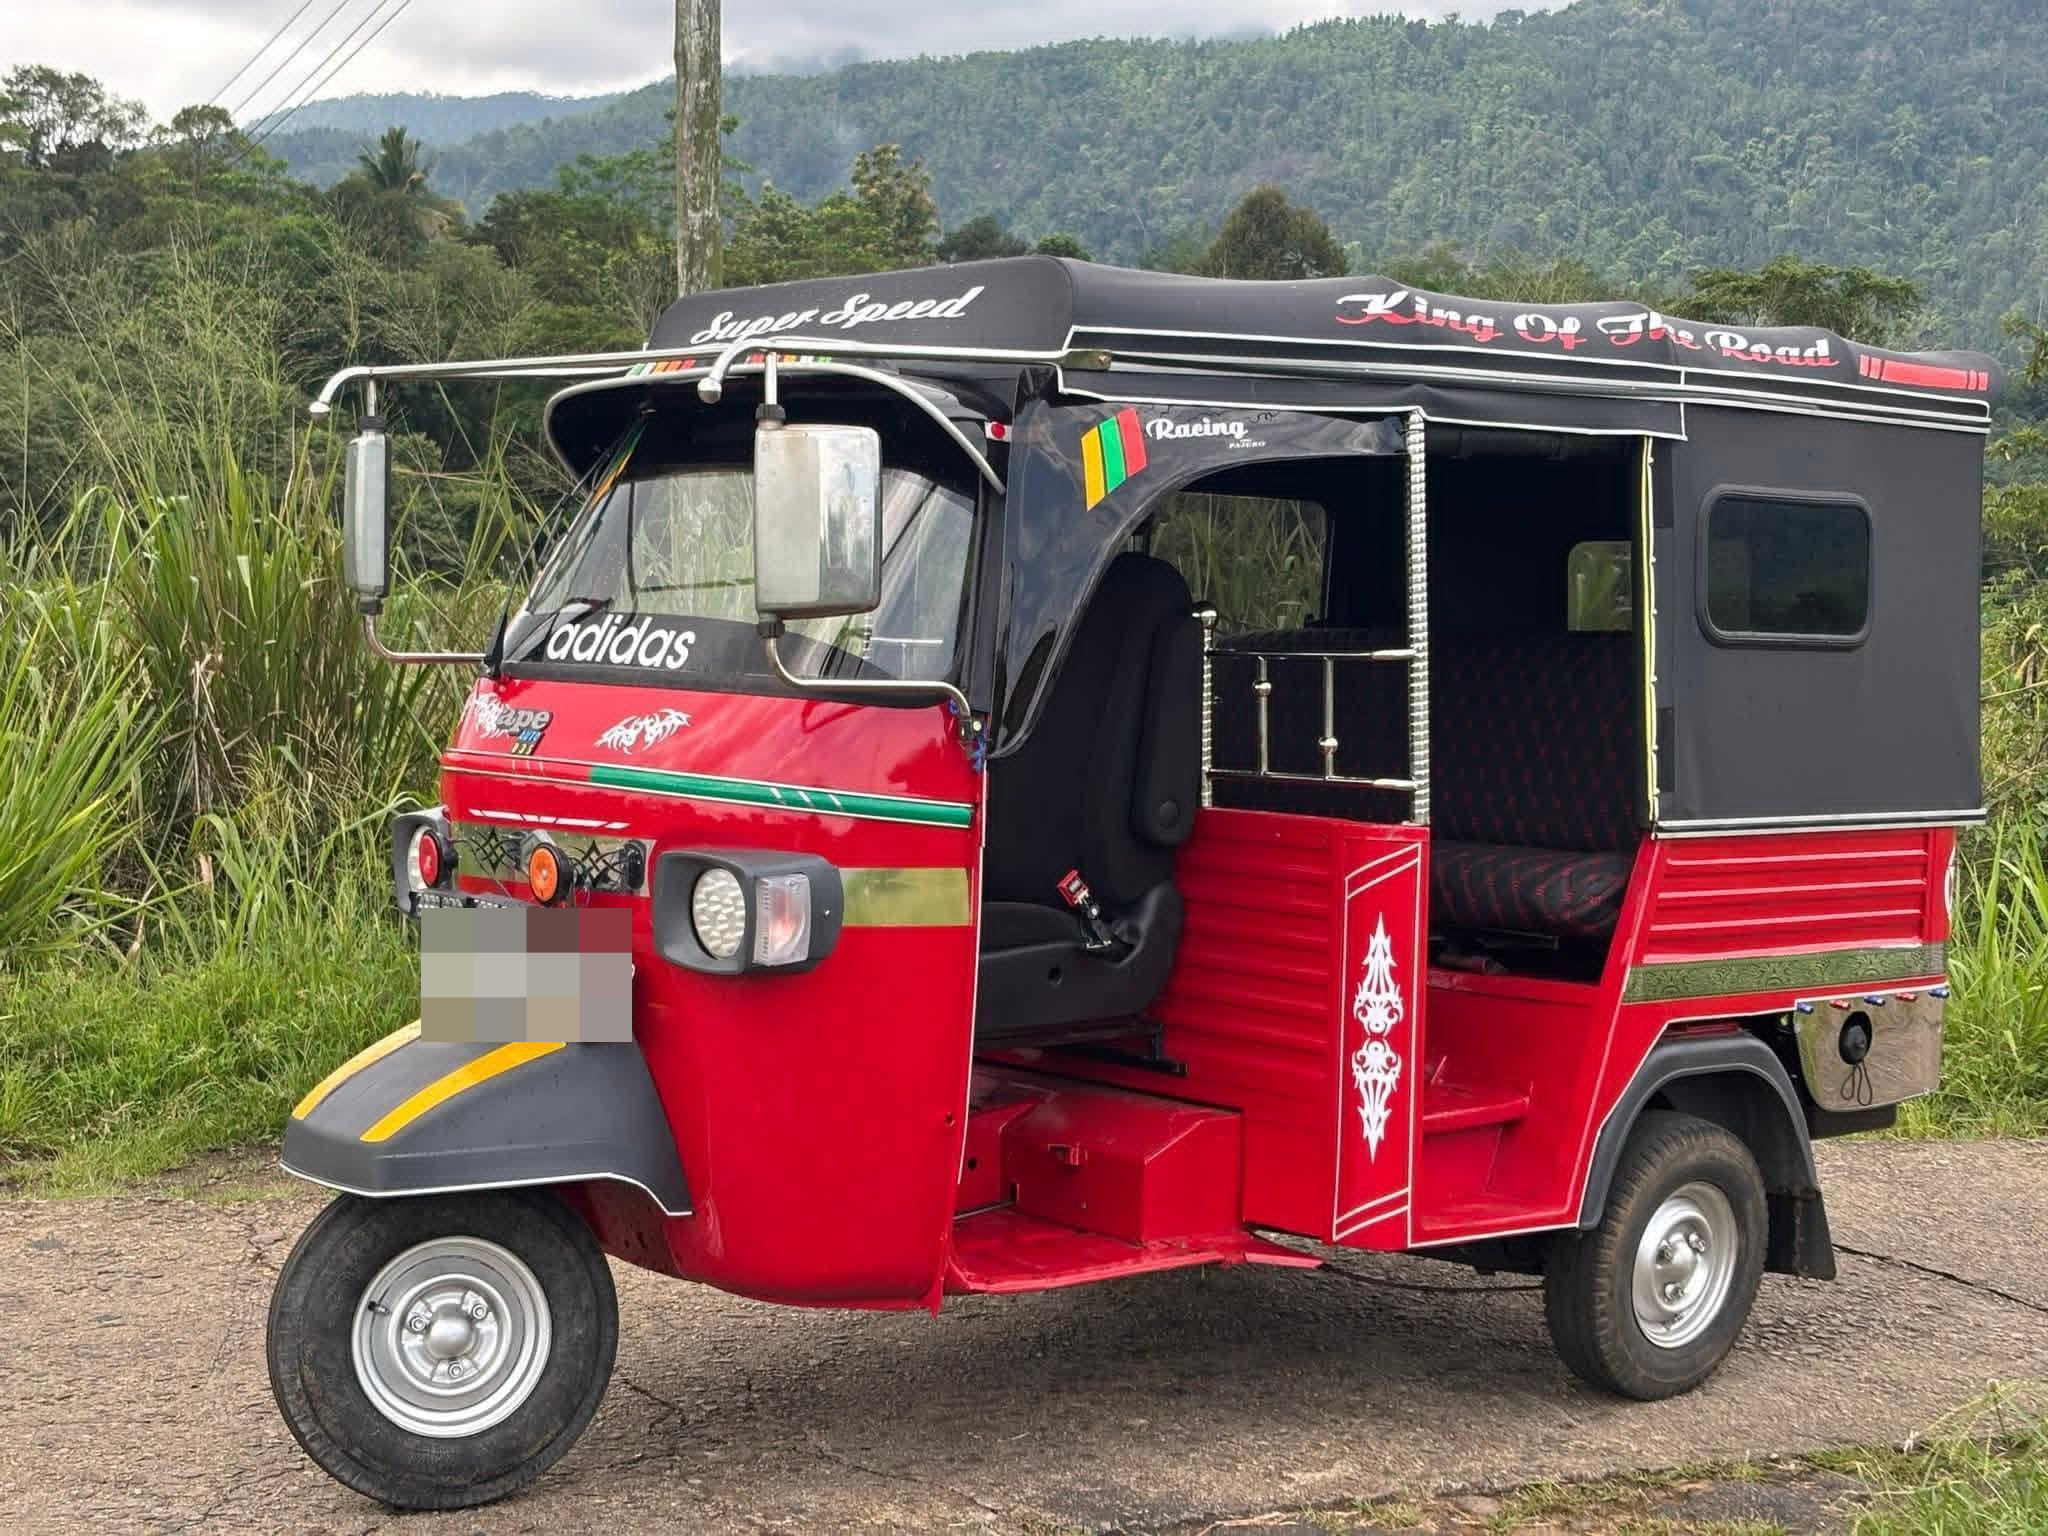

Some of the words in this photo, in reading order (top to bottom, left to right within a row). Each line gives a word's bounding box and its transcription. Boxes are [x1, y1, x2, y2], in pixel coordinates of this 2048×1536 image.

[690, 311, 819, 344] Super
[820, 286, 985, 329] Speed
[1336, 291, 1504, 343] King
[1513, 314, 1587, 350] Of
[1596, 312, 1702, 350] The
[1704, 331, 1840, 367] Road
[1146, 417, 1248, 439] Racing
[547, 614, 696, 669] adidas
